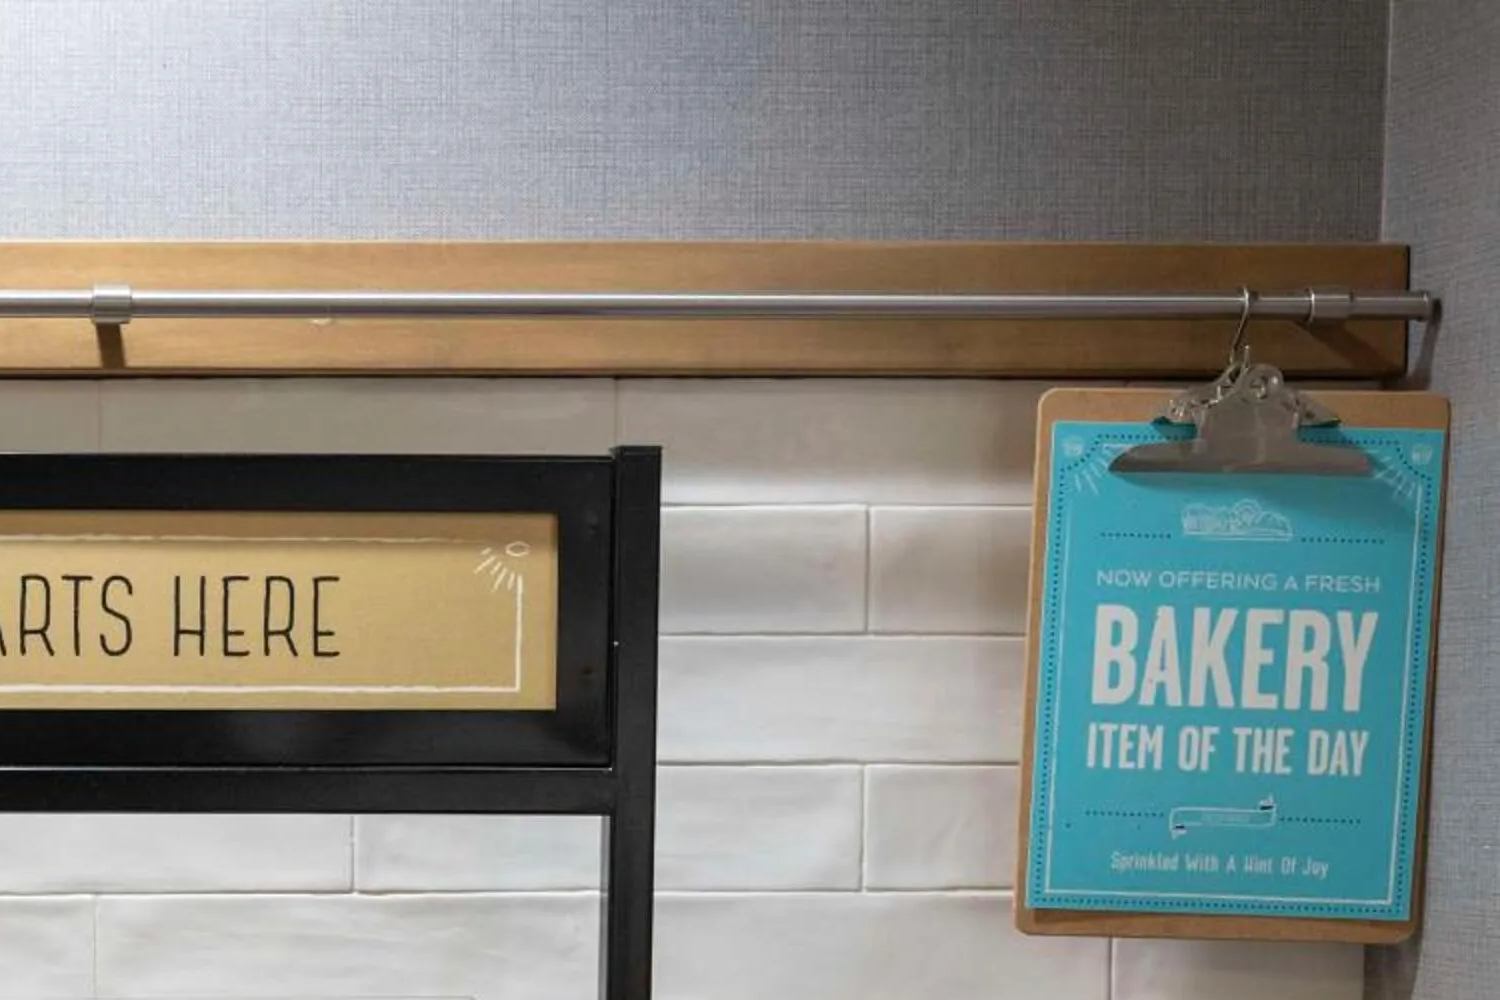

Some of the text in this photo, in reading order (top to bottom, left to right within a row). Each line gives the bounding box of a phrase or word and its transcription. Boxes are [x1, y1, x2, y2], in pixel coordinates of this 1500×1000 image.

[1097, 569, 1381, 593] NOW OFFERING A FRESH
[173, 575, 341, 658] HERE
[1090, 604, 1379, 712] BAKERY
[1086, 722, 1370, 776] ITEM OF THE DAY
[1110, 850, 1329, 880] Sprinkled With A Hint Of Joy
